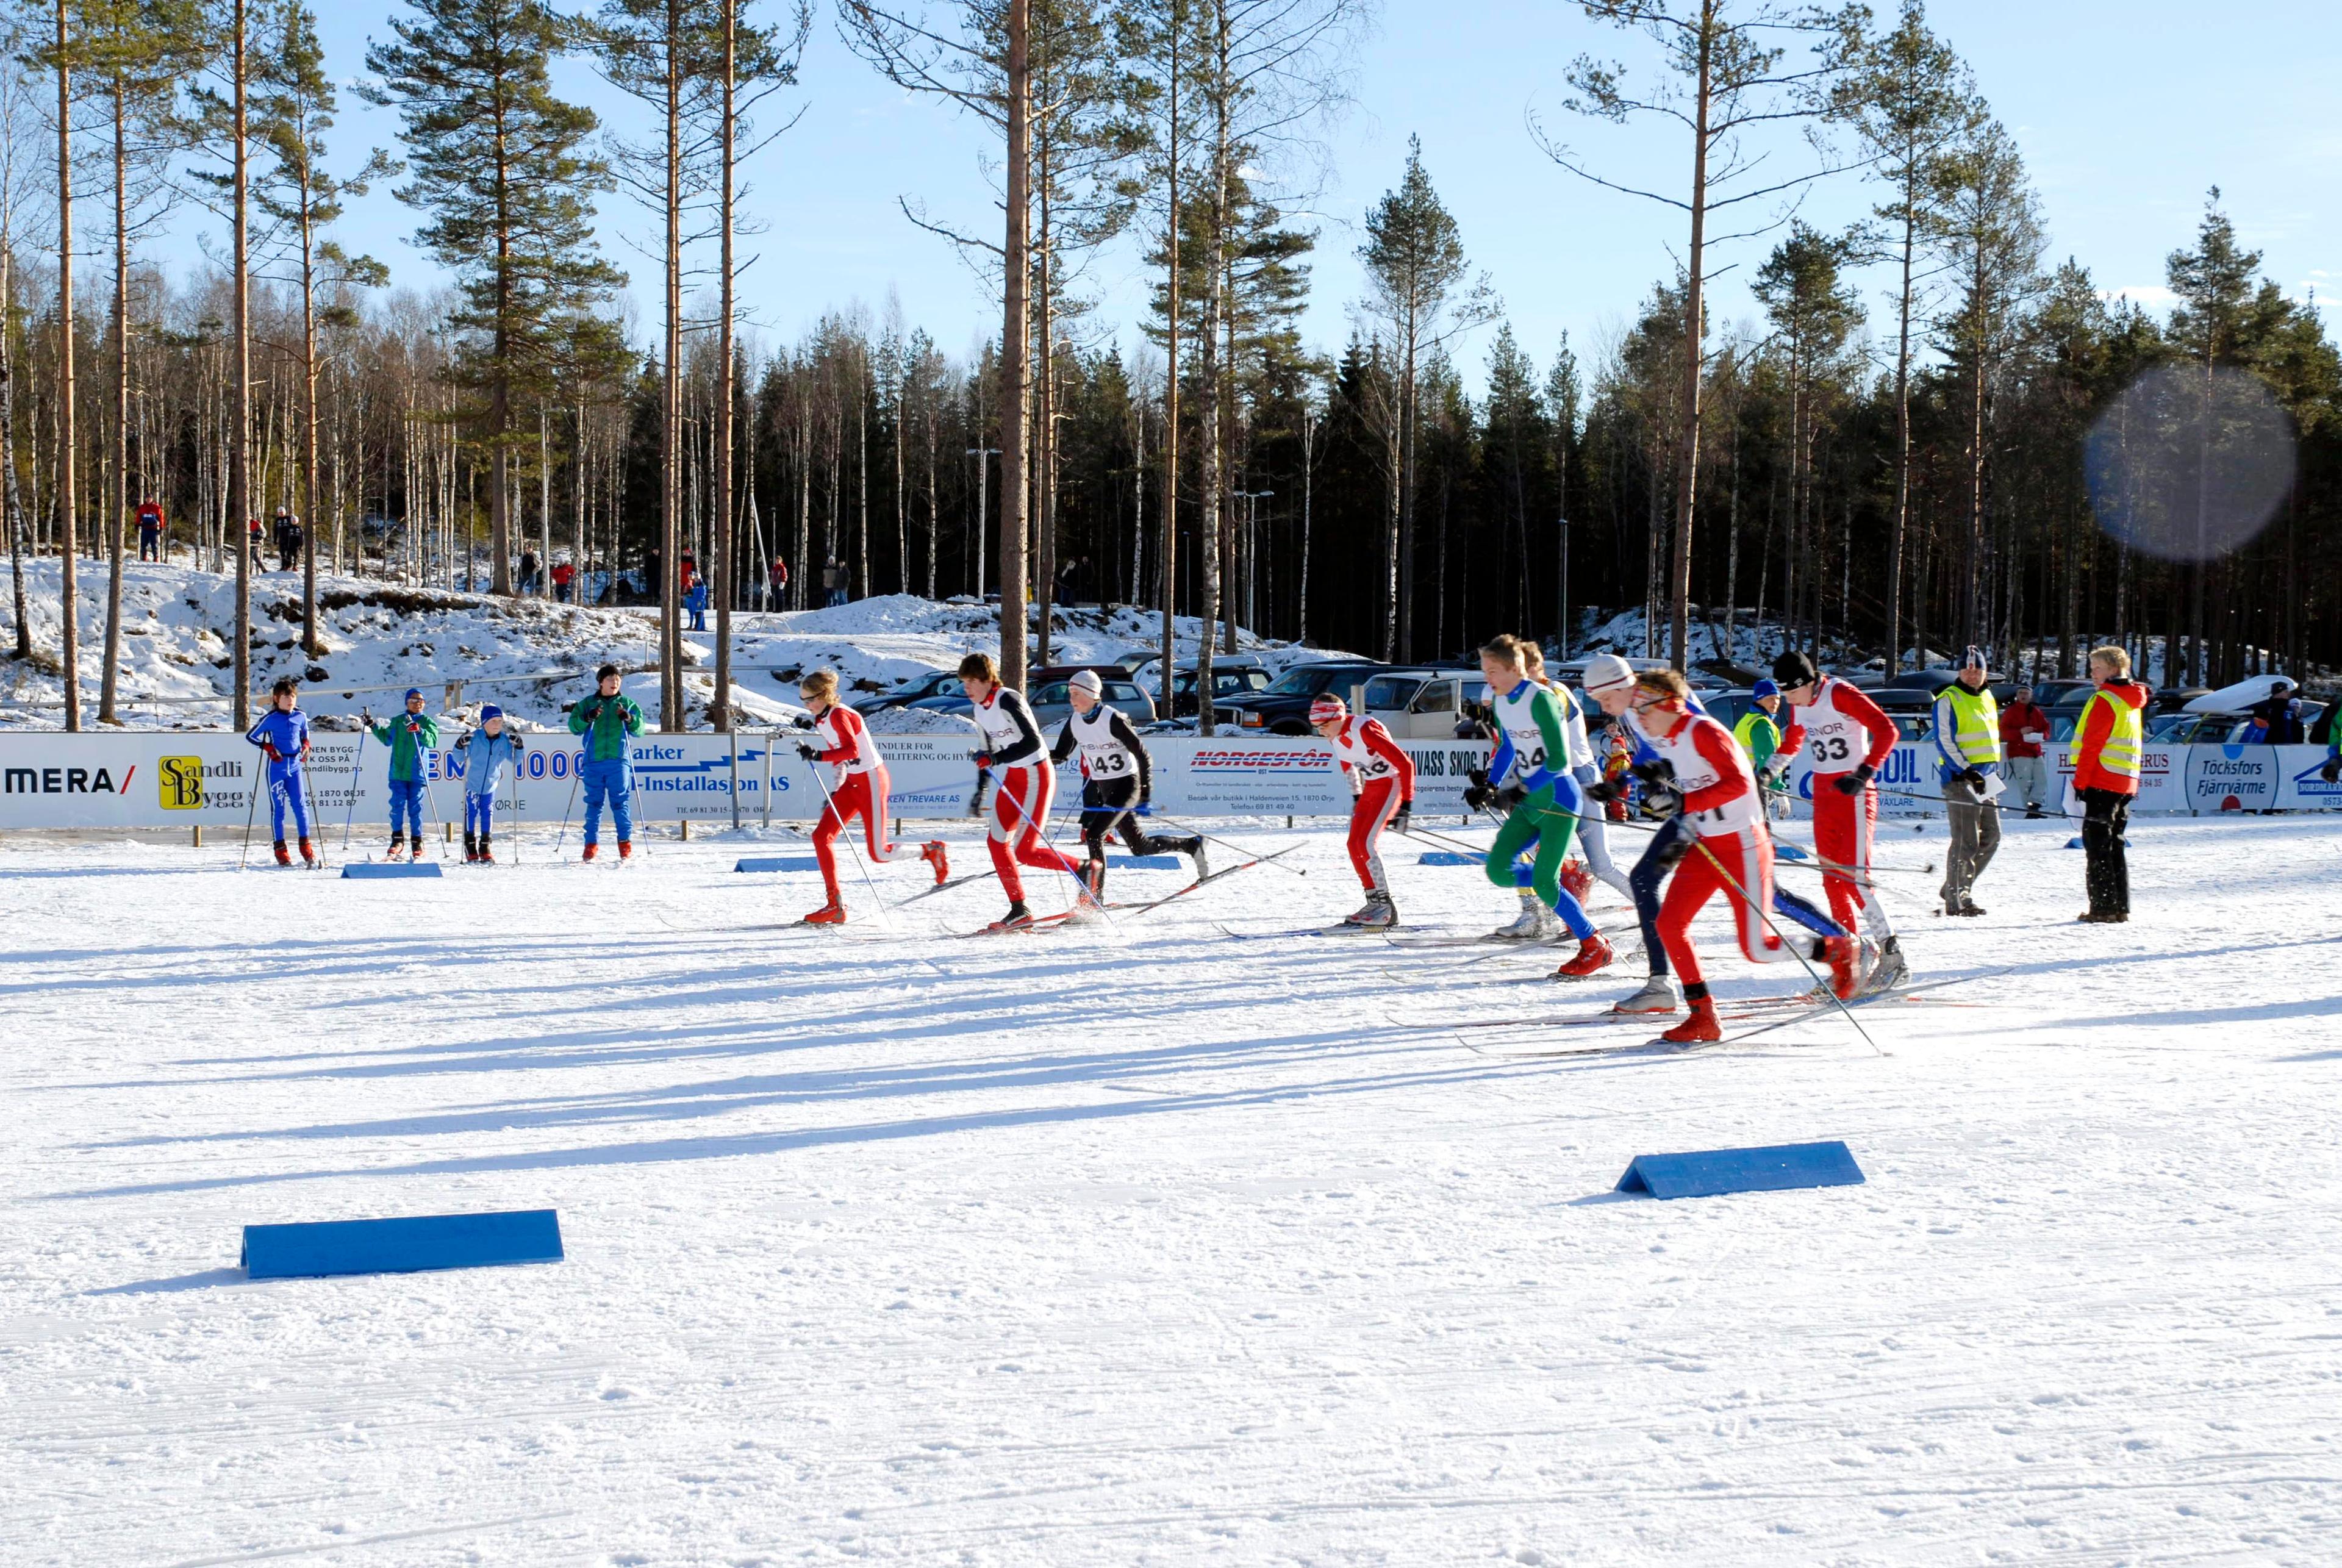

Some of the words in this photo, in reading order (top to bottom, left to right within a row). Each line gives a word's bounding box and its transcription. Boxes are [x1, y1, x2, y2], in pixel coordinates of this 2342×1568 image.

[338, 754, 350, 762] PÅ
[630, 745, 685, 760] arker
[1450, 750, 1477, 776] SKOG
[1874, 749, 1921, 784] OIL
[2202, 759, 2263, 775] Töcksfors
[162, 759, 242, 786] Sandli
[172, 777, 243, 809] Bygg
[631, 776, 758, 795] l-Installasjon
[2197, 779, 2266, 797] Fjärrvärme
[887, 795, 905, 803] KEN
[908, 795, 946, 803] TREVARE
[948, 795, 961, 803] AS
